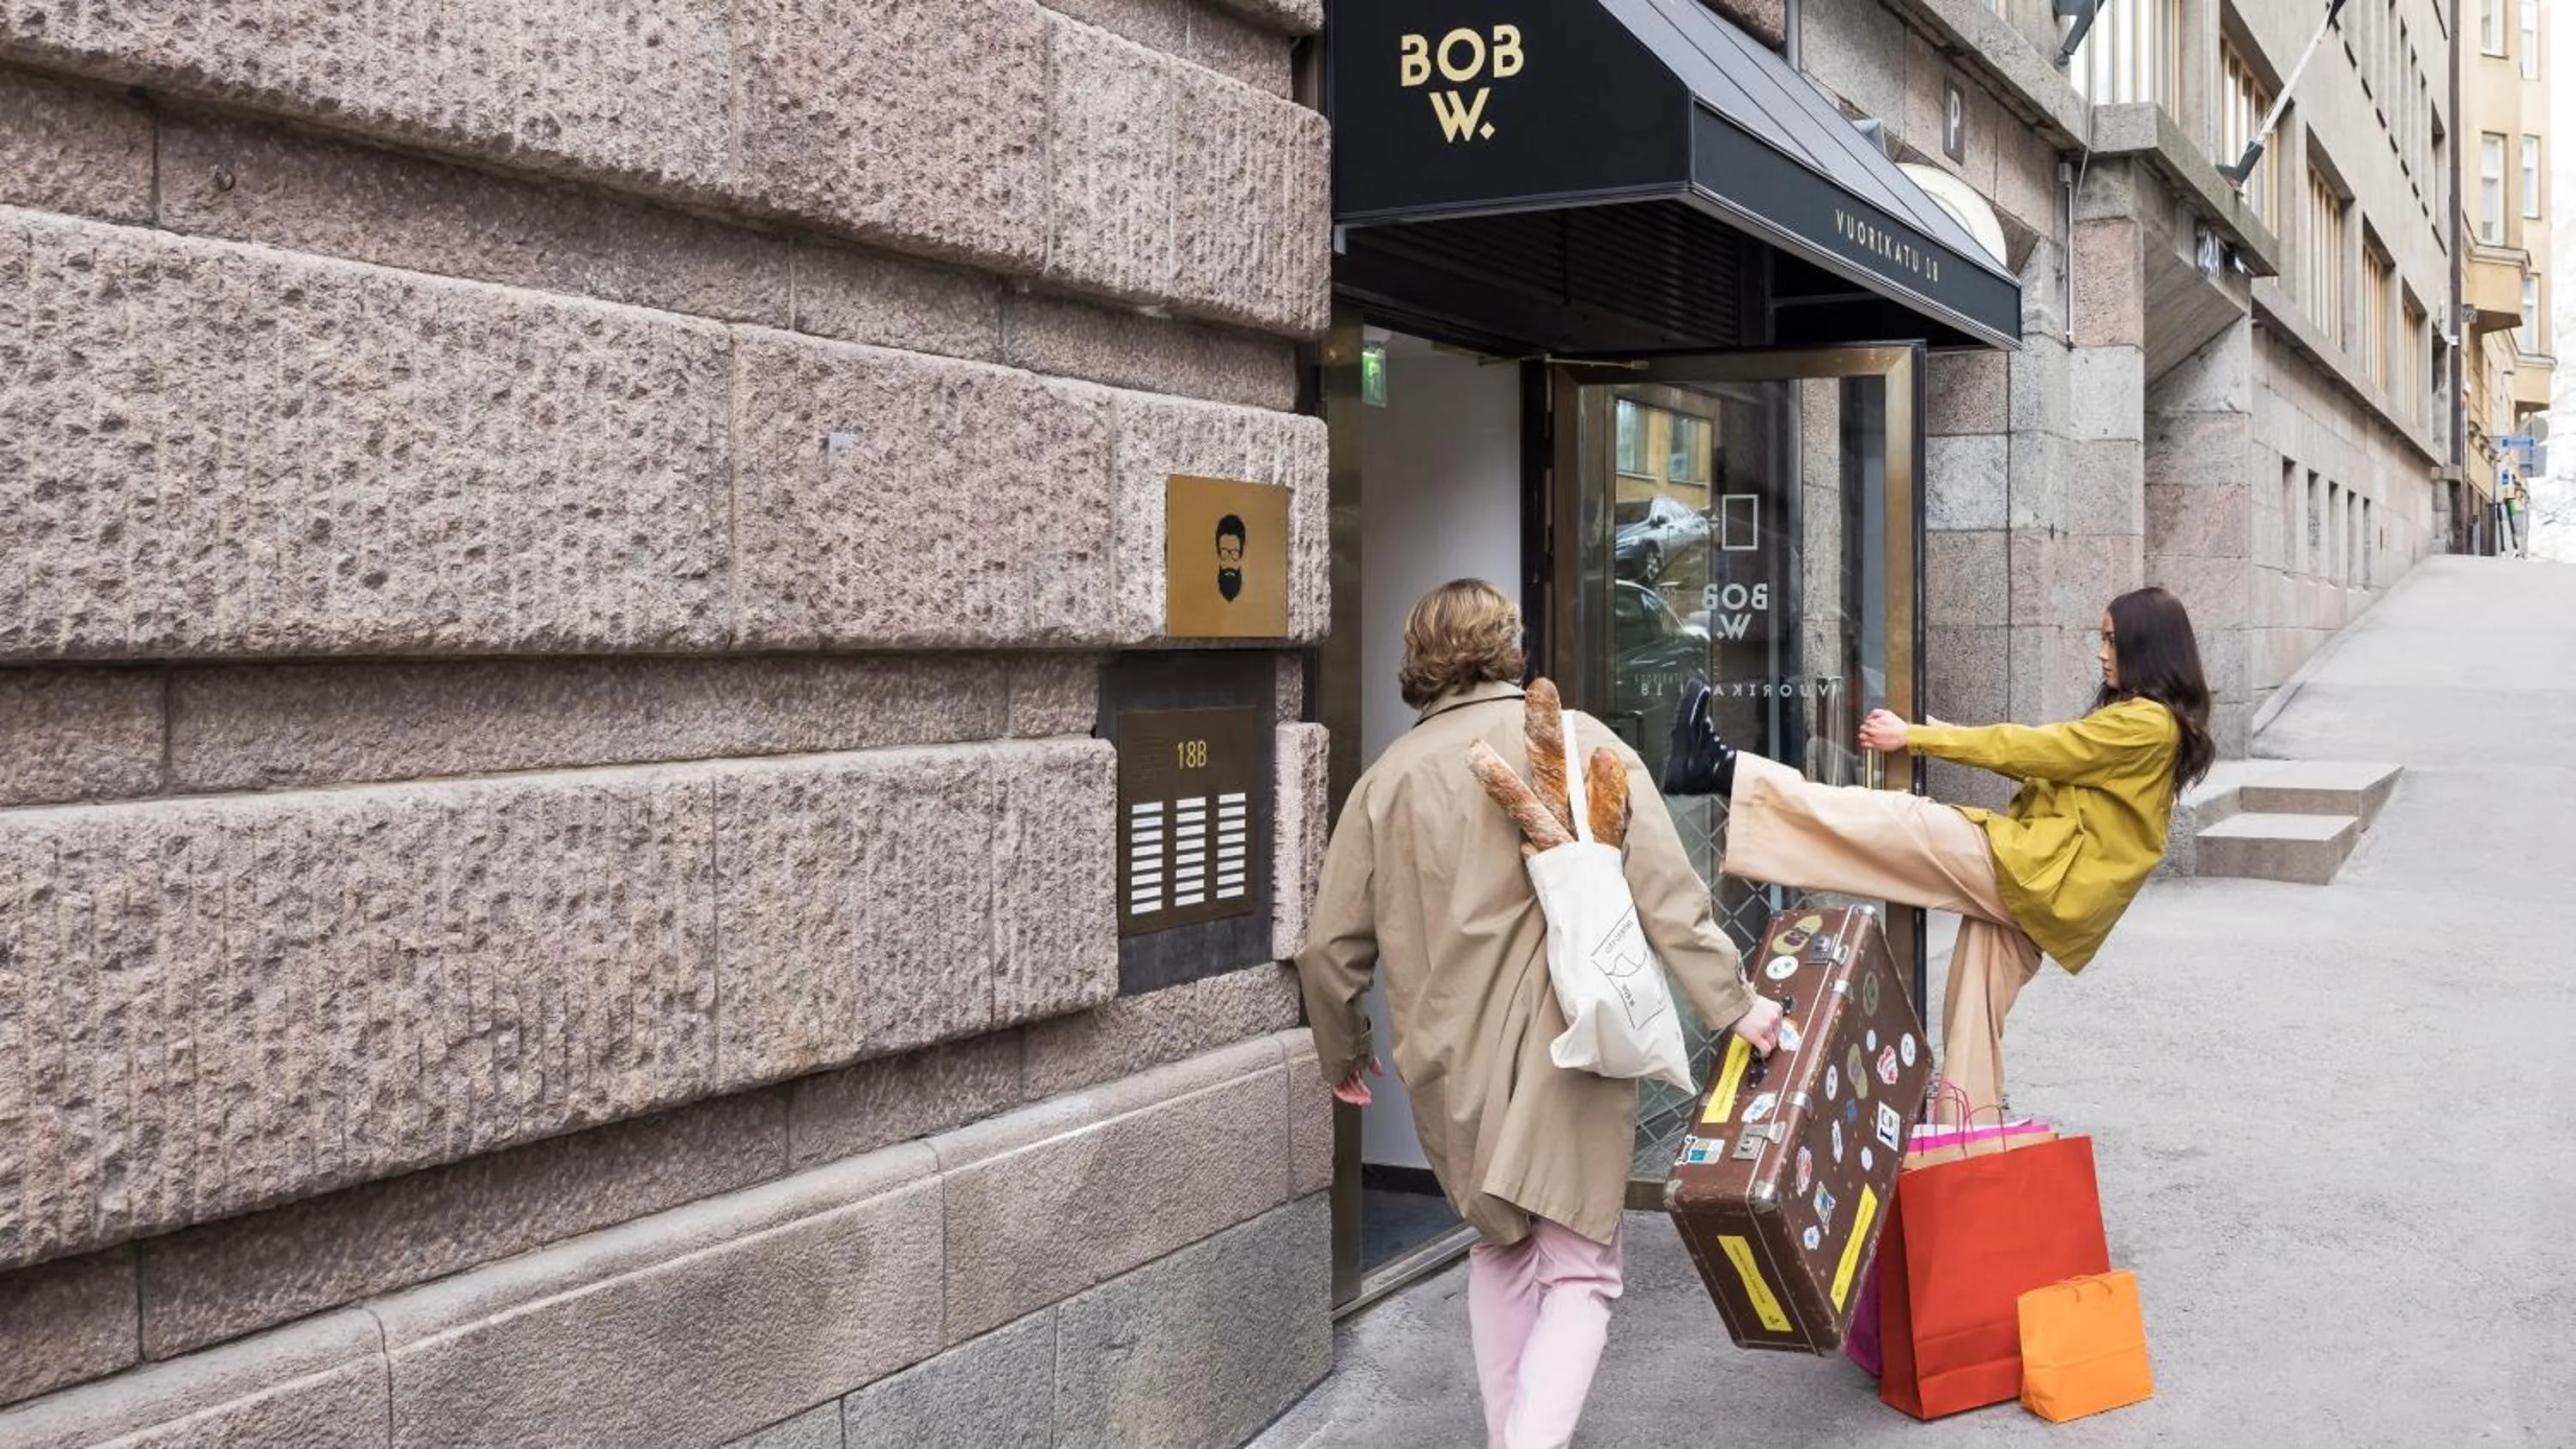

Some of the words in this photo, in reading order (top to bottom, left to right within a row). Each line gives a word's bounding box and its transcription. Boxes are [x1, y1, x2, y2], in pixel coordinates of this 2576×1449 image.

[1401, 24, 1524, 87] BOB
[1950, 89, 1960, 149] P
[1836, 209, 1919, 273] VUORIKATU
[1177, 740, 1207, 769] 18B
